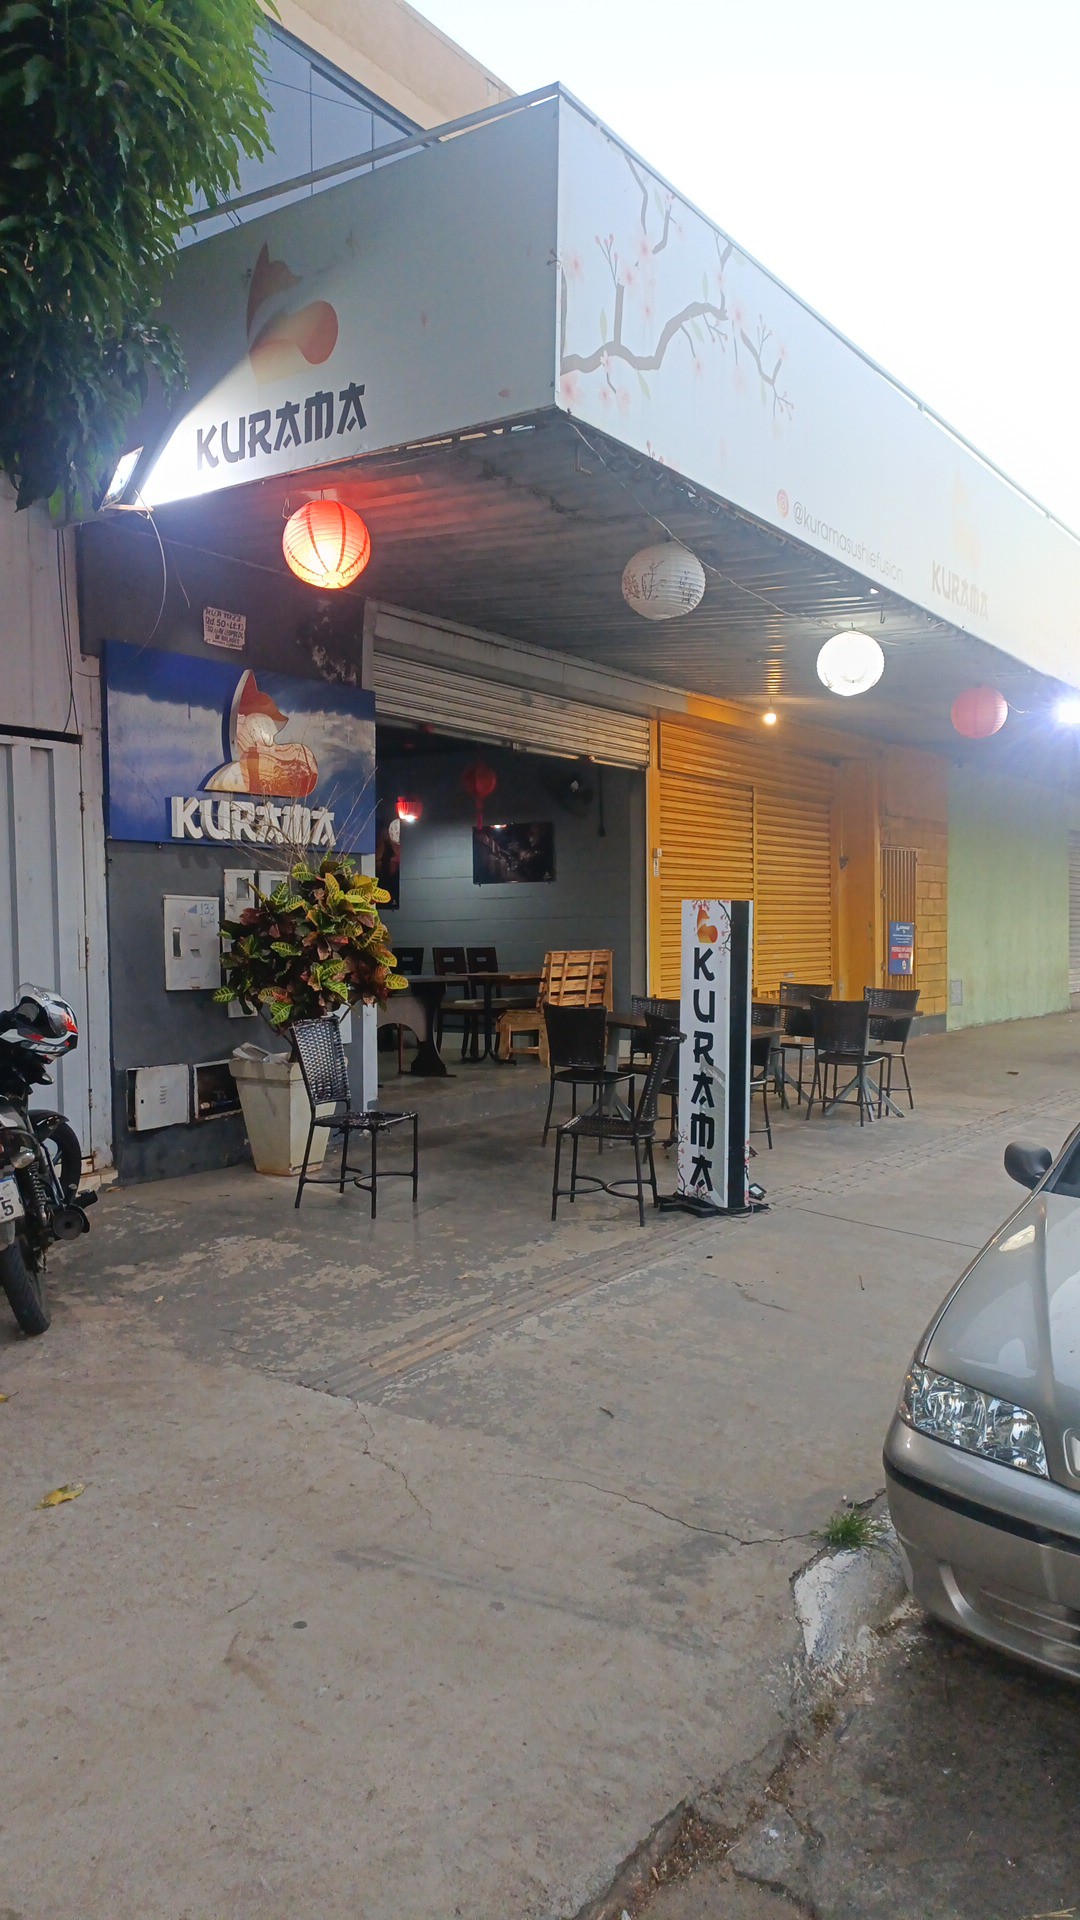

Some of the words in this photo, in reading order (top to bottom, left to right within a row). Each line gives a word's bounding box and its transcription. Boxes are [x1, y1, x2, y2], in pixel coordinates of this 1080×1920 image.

[196, 382, 367, 471] KURAMA
[205, 609, 221, 618] RUA
[931, 560, 989, 622] KURAMA
[171, 796, 336, 846] KURAMA
[689, 947, 716, 1191] KURAMA
[0, 1196, 14, 1216] 5
